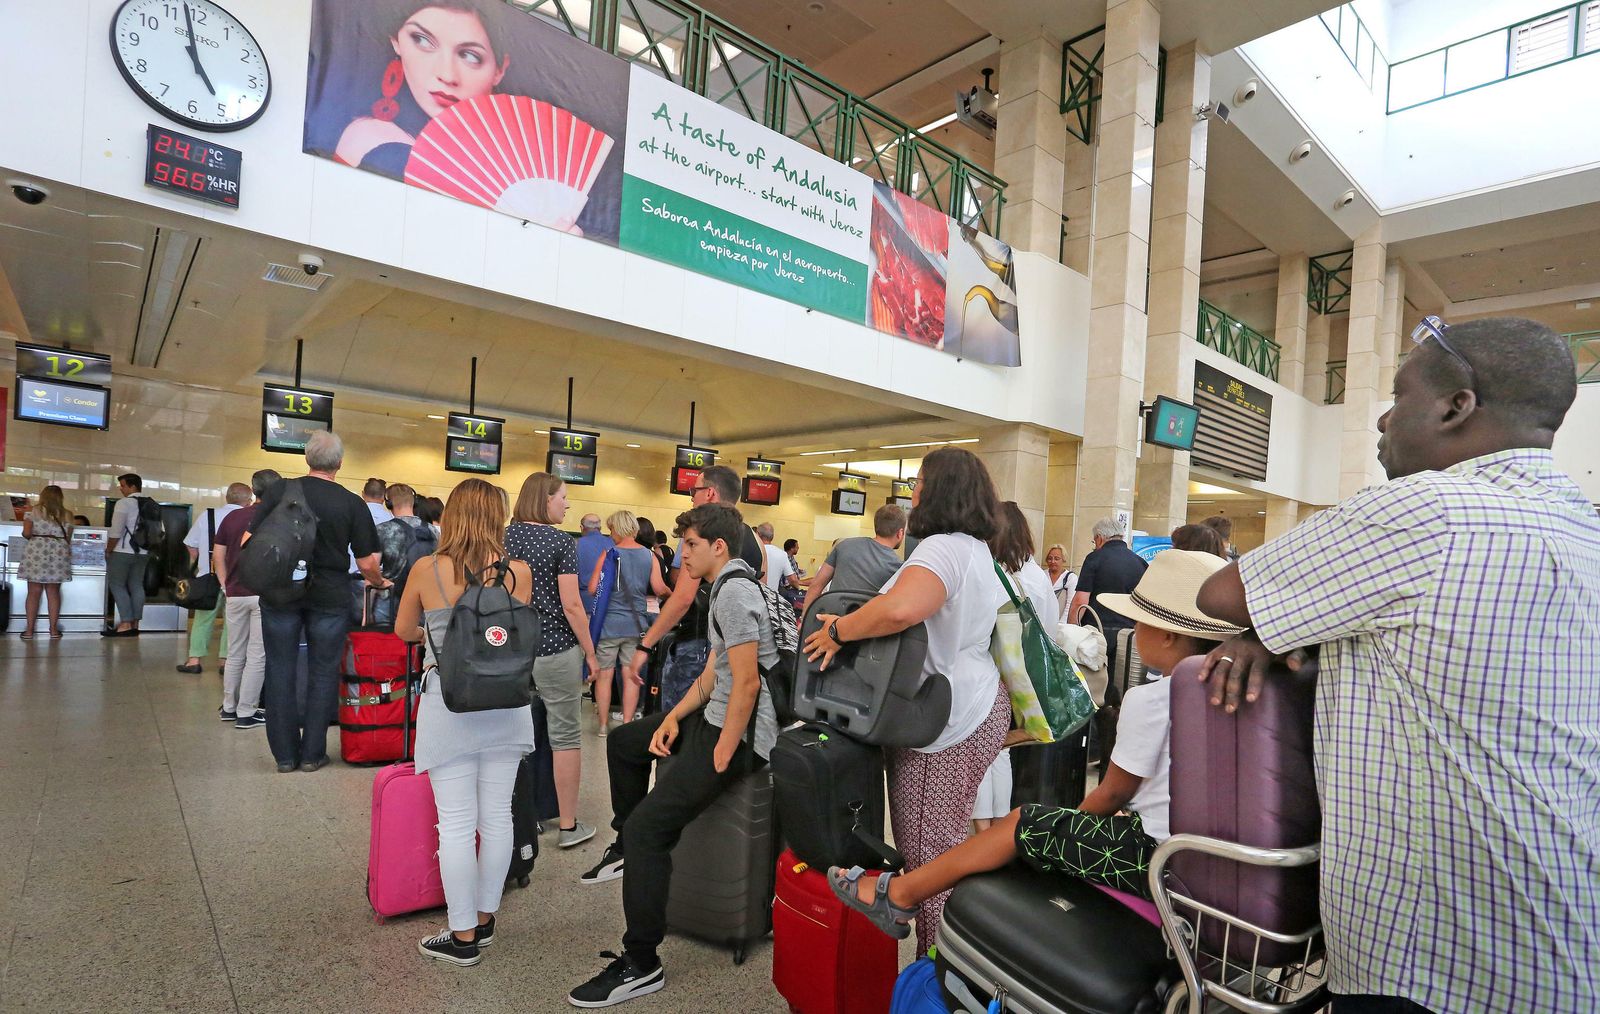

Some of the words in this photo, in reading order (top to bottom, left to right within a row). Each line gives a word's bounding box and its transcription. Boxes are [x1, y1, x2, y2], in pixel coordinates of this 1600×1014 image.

[163, 4, 177, 21] 11
[190, 8, 207, 26] 12
[139, 13, 159, 31] 10
[129, 32, 140, 47] 9
[174, 26, 220, 49] SEIKO
[224, 27, 229, 41] 1
[240, 49, 250, 64] 2
[136, 58, 147, 73] 8
[160, 82, 170, 97] 7
[248, 74, 257, 90] 3
[187, 100, 198, 114] 6
[217, 103, 226, 118] 5
[651, 102, 673, 132] A
[678, 112, 741, 158] taste
[746, 146, 766, 170] of
[772, 157, 858, 212] Andalusia
[207, 174, 238, 193] %HR
[638, 136, 659, 154] at
[662, 142, 691, 168] the
[694, 161, 756, 195] airport...
[761, 187, 798, 212] start
[800, 204, 825, 225] with
[829, 211, 864, 239] Jerez
[641, 197, 700, 231] Saborea
[702, 220, 763, 253] Andalucía
[765, 245, 779, 260] en
[782, 250, 792, 263] el
[794, 256, 855, 287] aeropuerto...
[700, 239, 749, 266] empieza
[751, 257, 769, 273] por
[774, 261, 805, 284] Jerez
[46, 356, 85, 380] 12
[284, 394, 313, 415] 13
[463, 420, 487, 438] 14
[563, 435, 583, 451] 15
[687, 452, 704, 467] 16
[757, 464, 772, 477] 17
